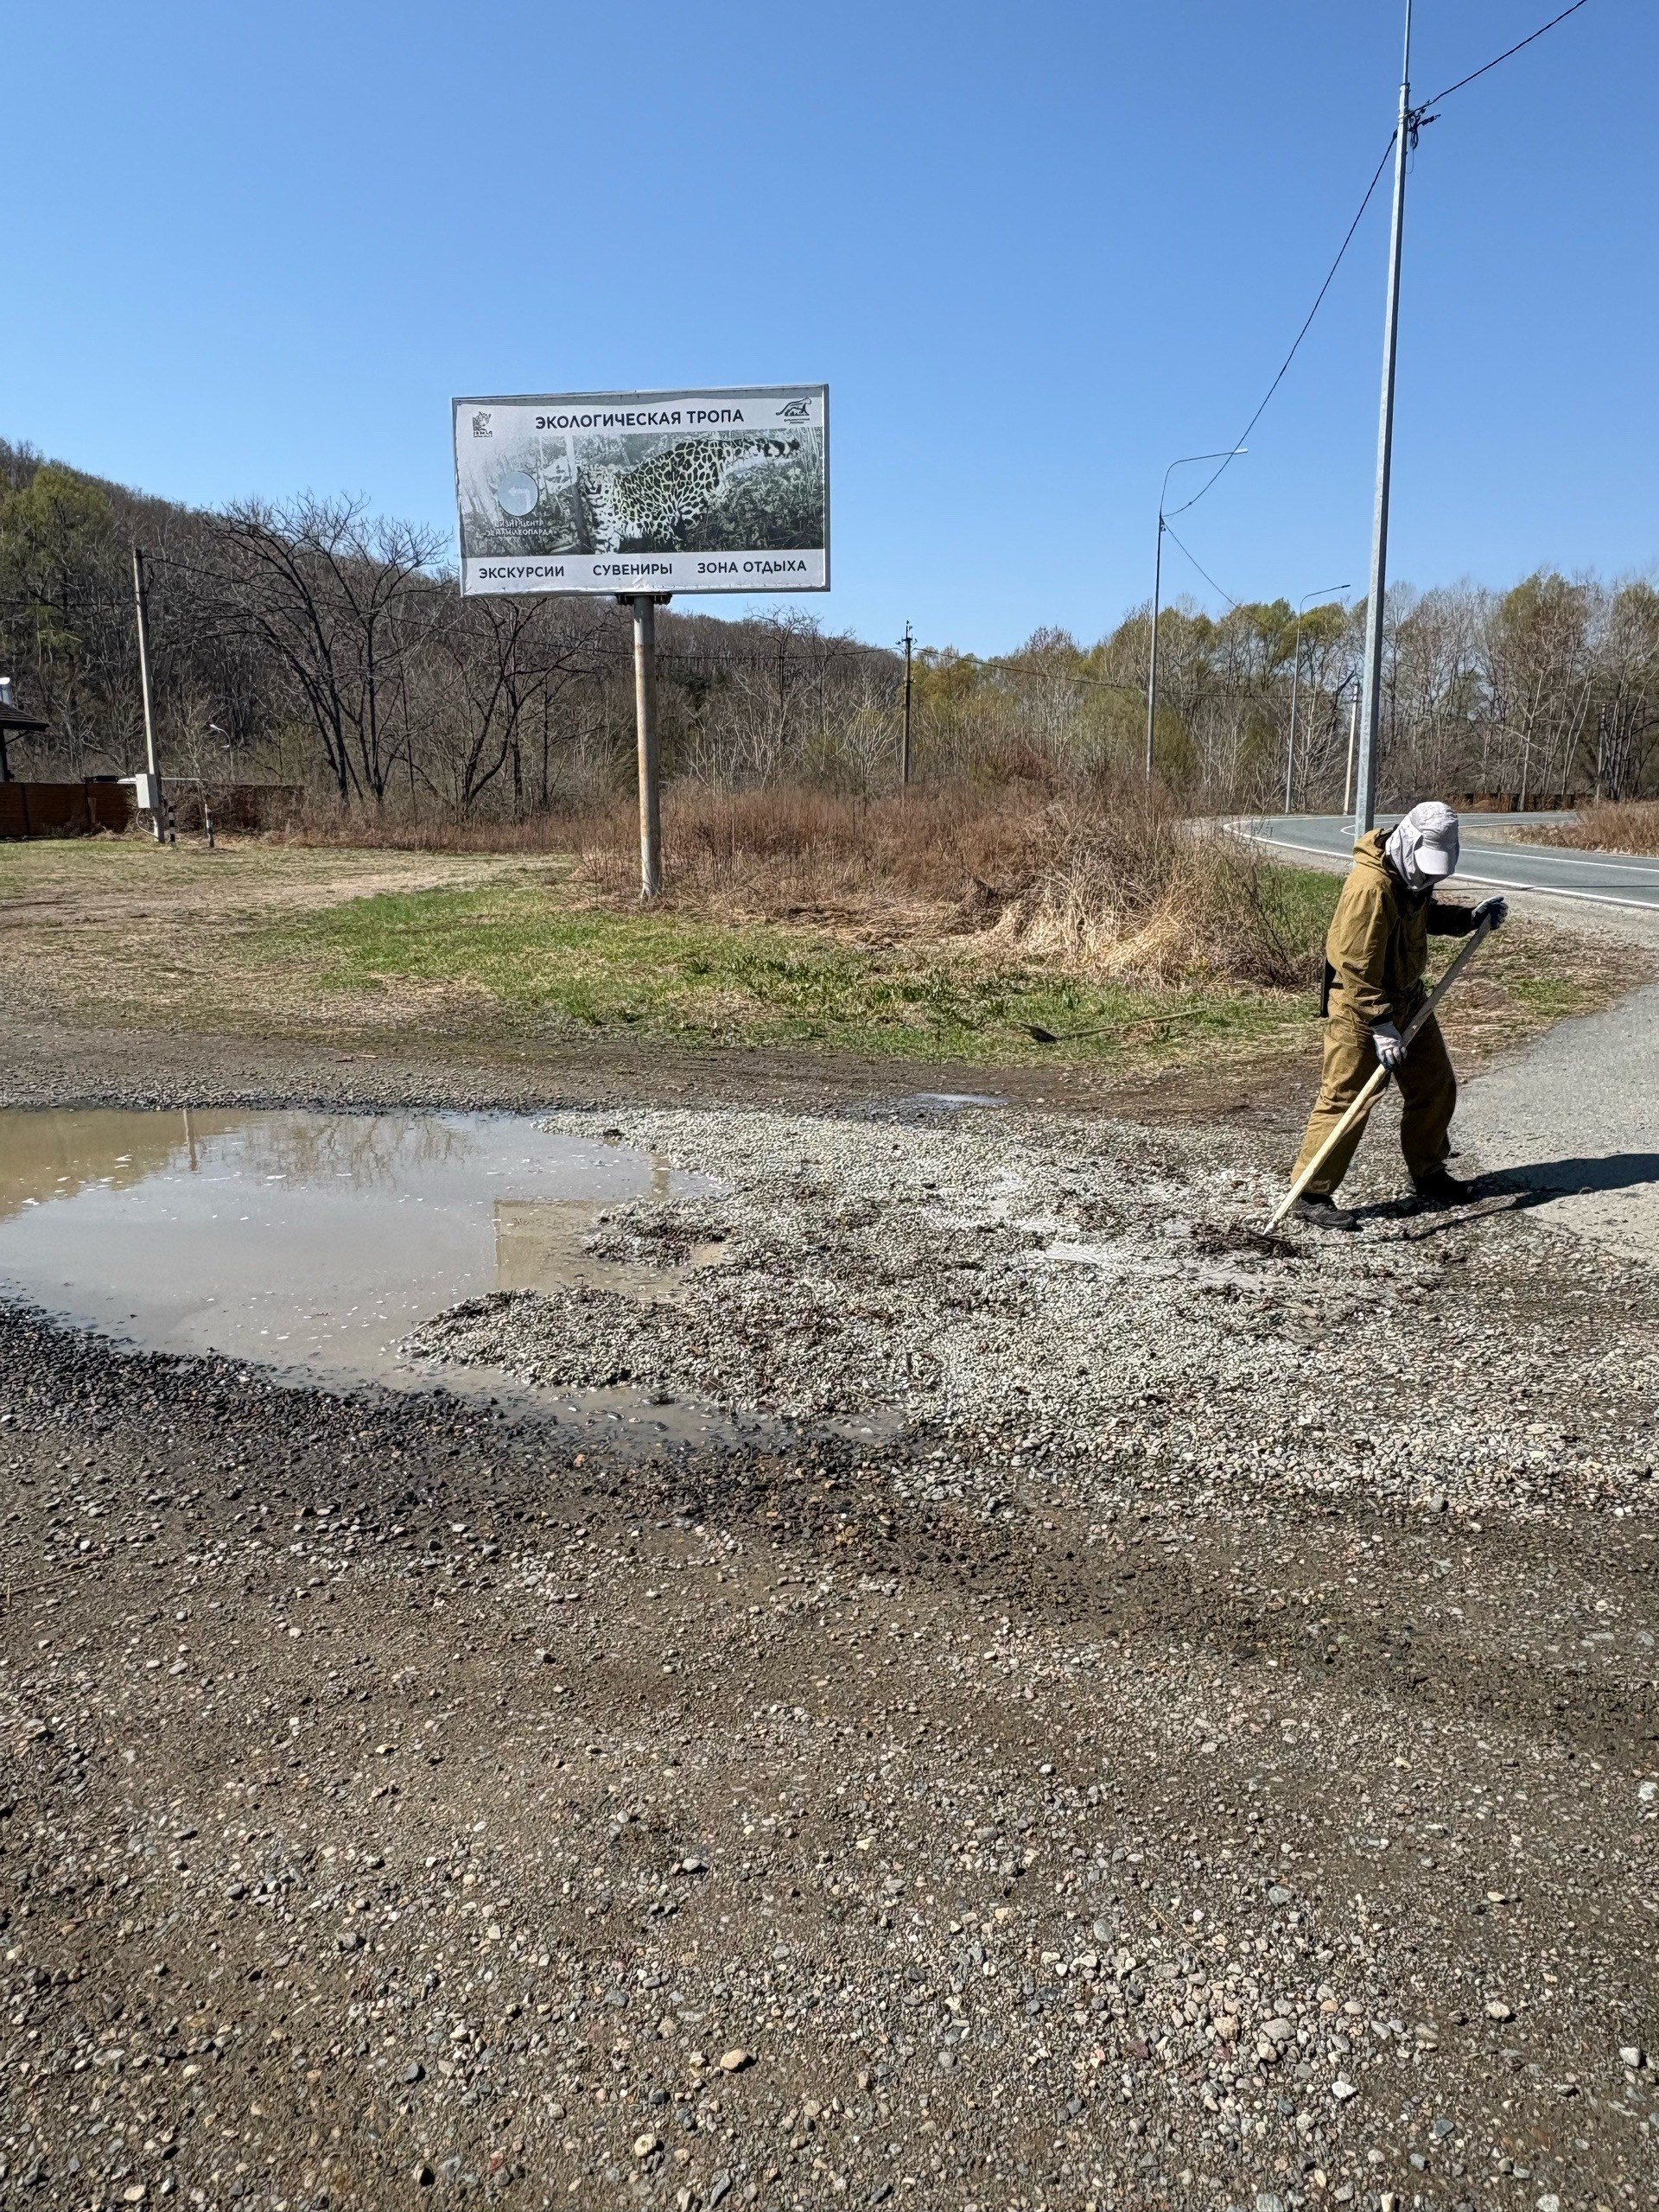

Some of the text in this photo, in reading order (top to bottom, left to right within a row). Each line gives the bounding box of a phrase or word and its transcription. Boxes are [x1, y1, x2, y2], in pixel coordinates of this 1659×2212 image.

[535, 409, 745, 429] ЭКОЛОГИЧЕСКАЯ ТРОПА
[479, 559, 807, 579] ЭКСКУРСИИ СУВЕНИРЫ ЗОНА ОТДЫХА
